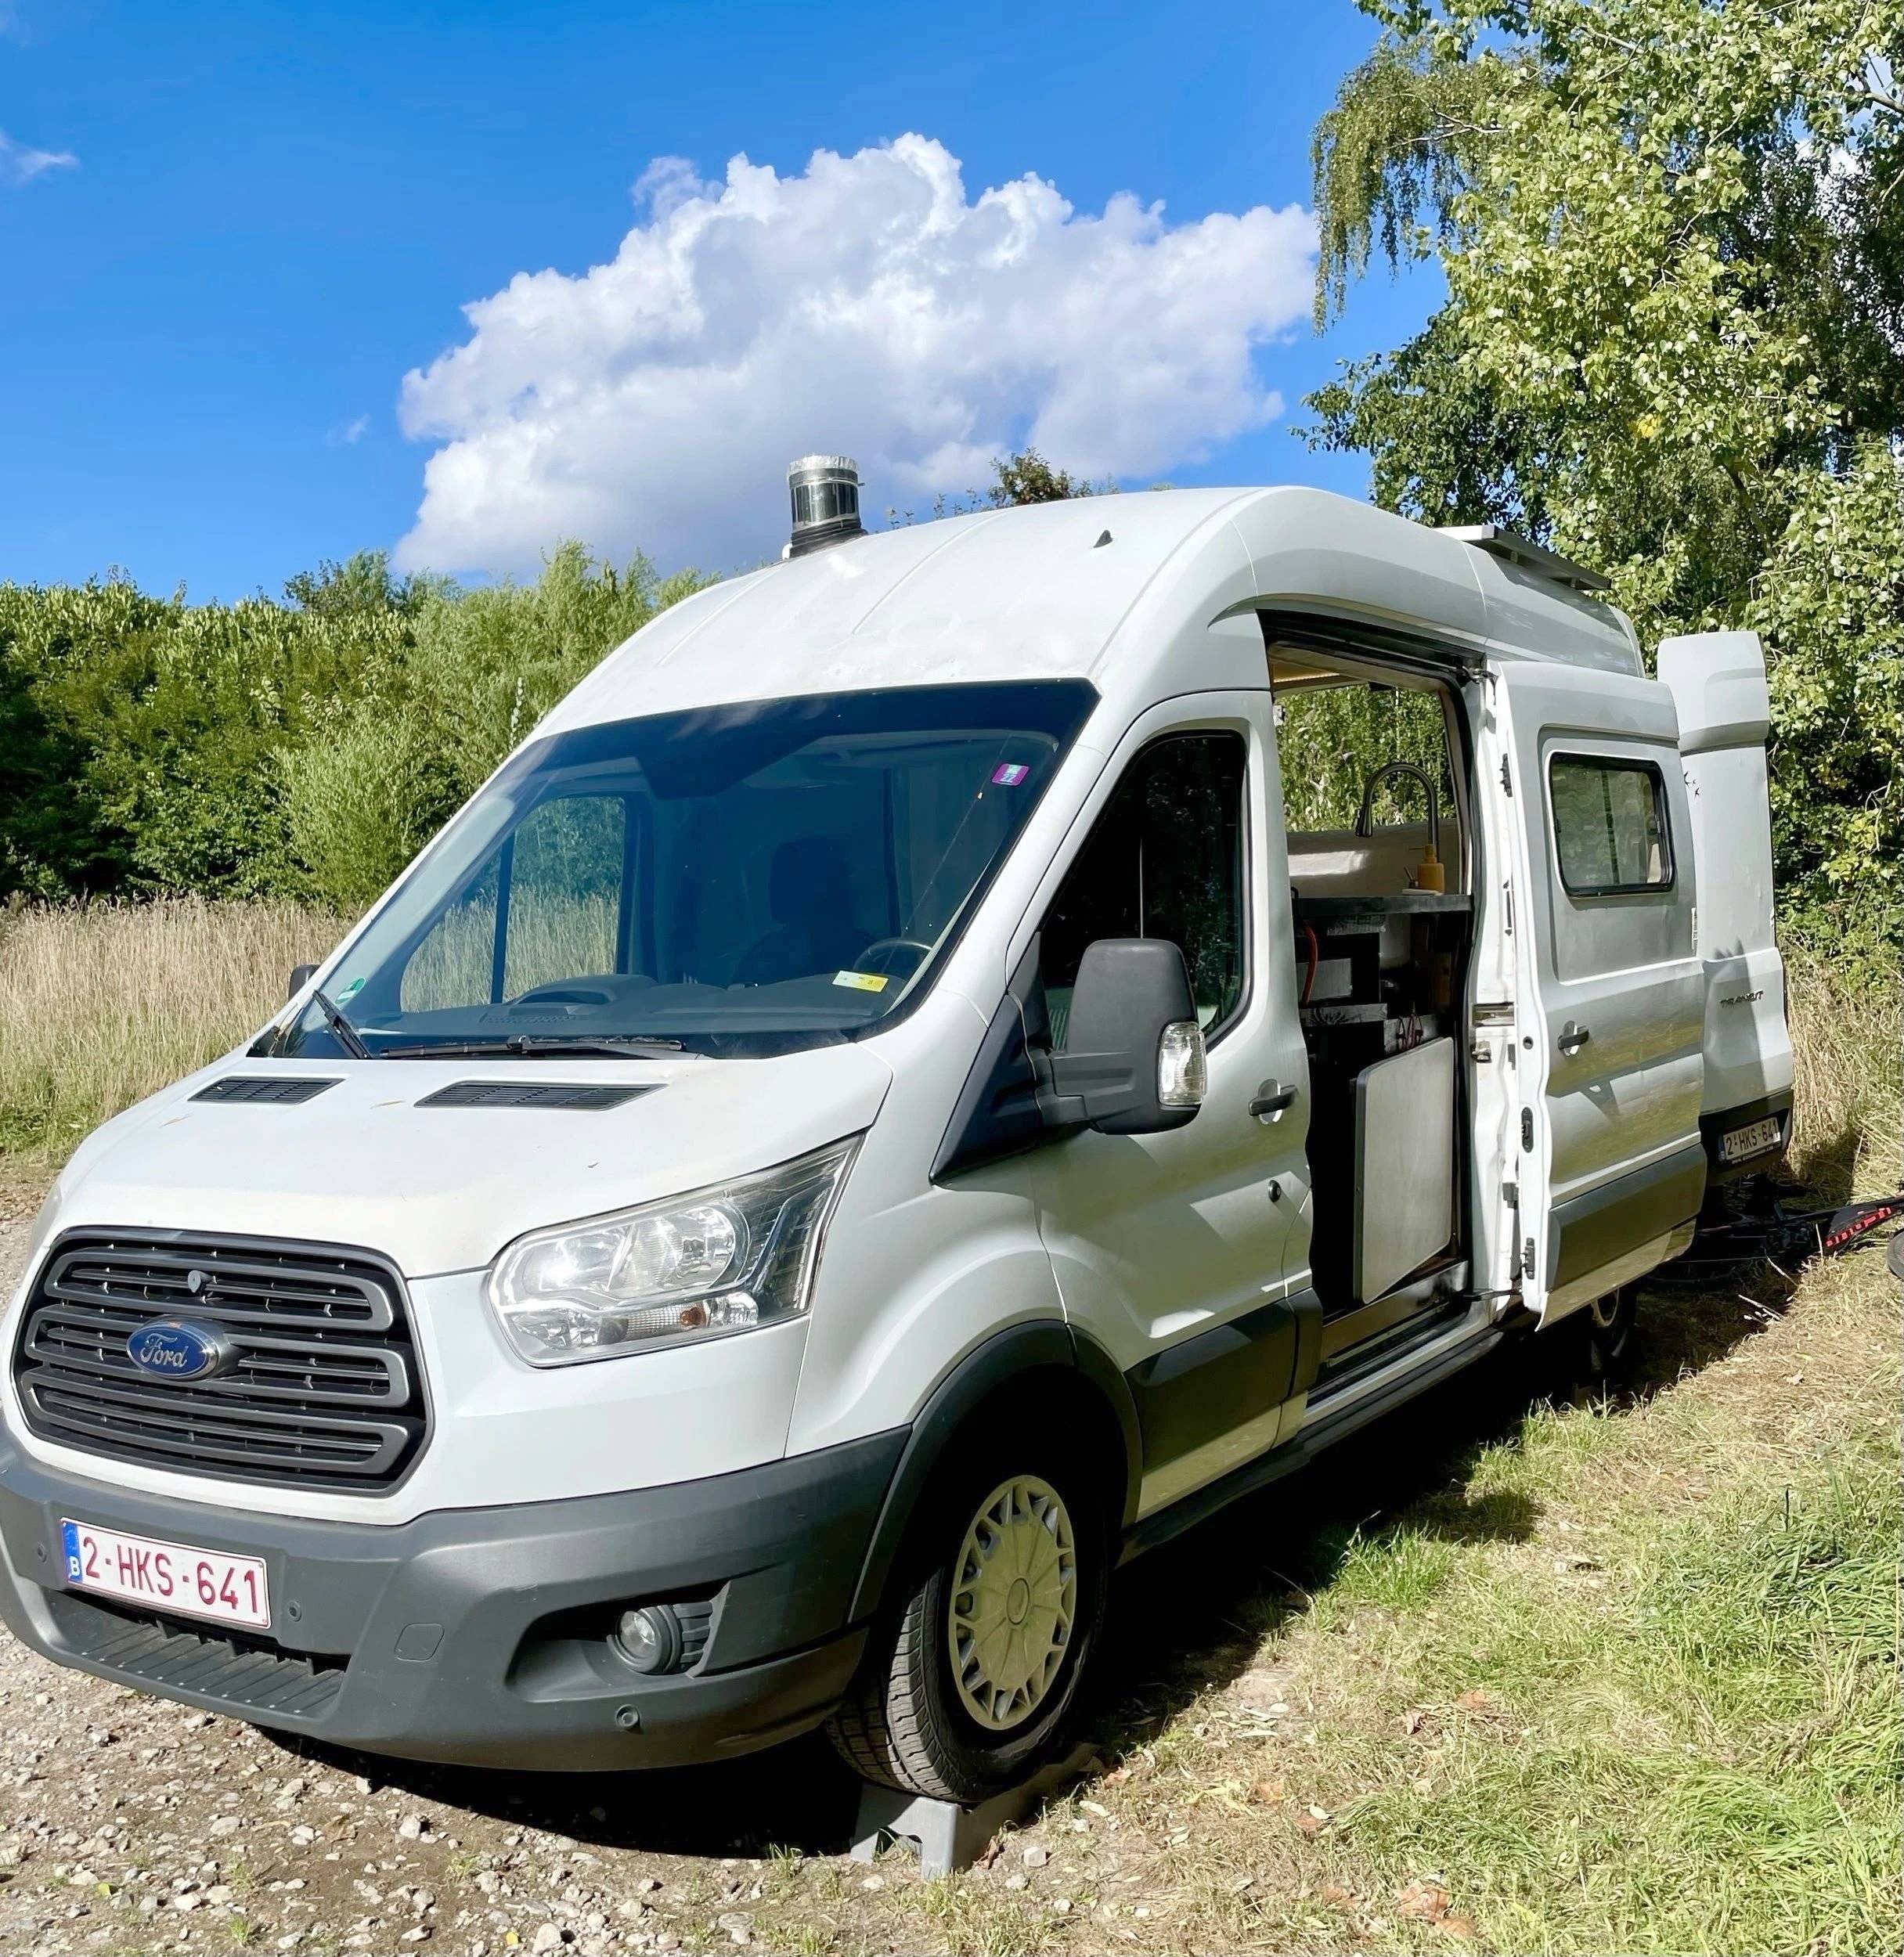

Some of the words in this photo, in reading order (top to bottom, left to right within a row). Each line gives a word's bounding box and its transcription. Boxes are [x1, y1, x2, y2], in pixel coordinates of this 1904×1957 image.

[139, 1332, 188, 1368] Ford
[70, 1555, 81, 1577] B
[83, 1537, 258, 1613] 2-HKS-641
